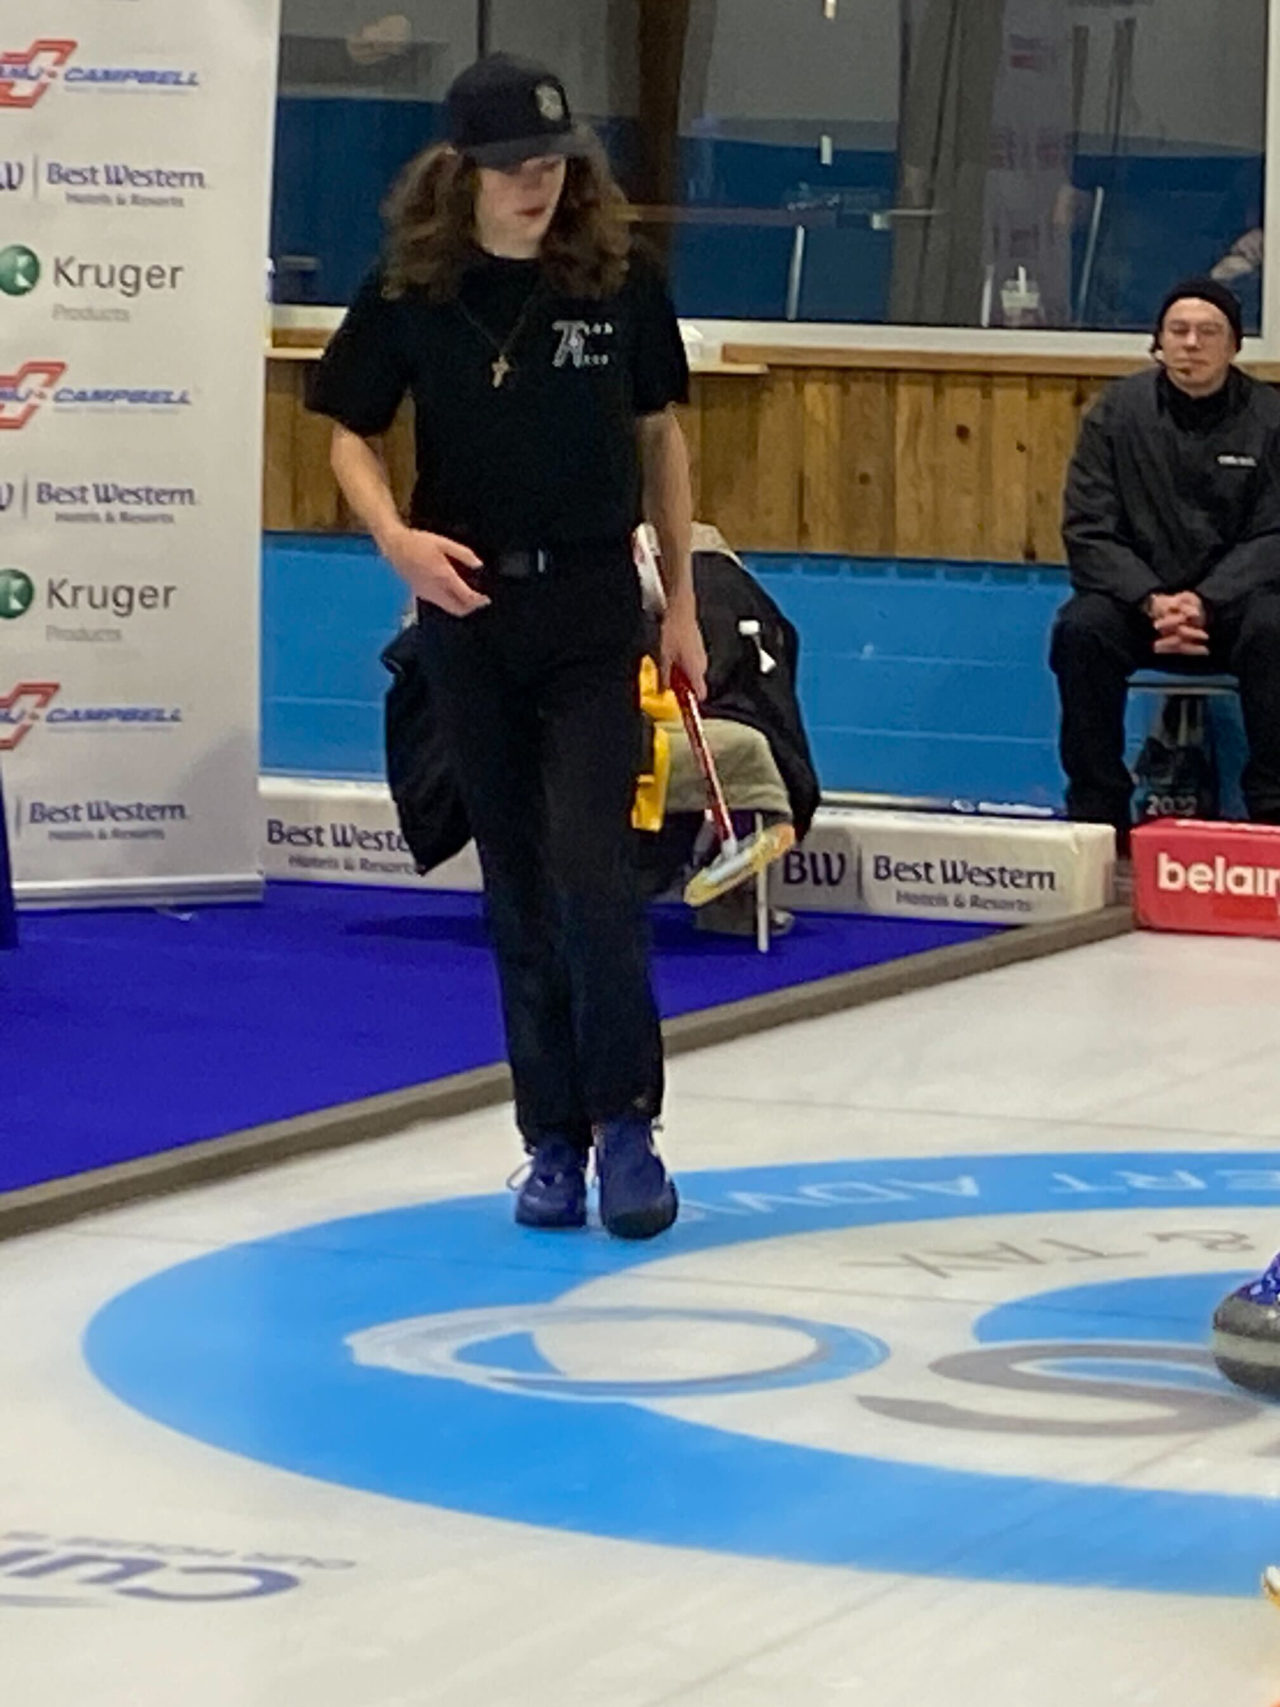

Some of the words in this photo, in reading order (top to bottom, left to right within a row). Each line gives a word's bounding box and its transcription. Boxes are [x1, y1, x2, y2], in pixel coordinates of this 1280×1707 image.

[47, 162, 100, 186] Best
[104, 164, 206, 189] Western
[53, 256, 184, 298] Kruger
[36, 482, 89, 504] Best
[93, 483, 196, 505] Western
[48, 577, 177, 617] Kruger
[29, 801, 83, 824] Best
[87, 801, 187, 821] Western
[266, 819, 325, 847] Best
[873, 855, 934, 883] Best
[939, 858, 1056, 891] Western
